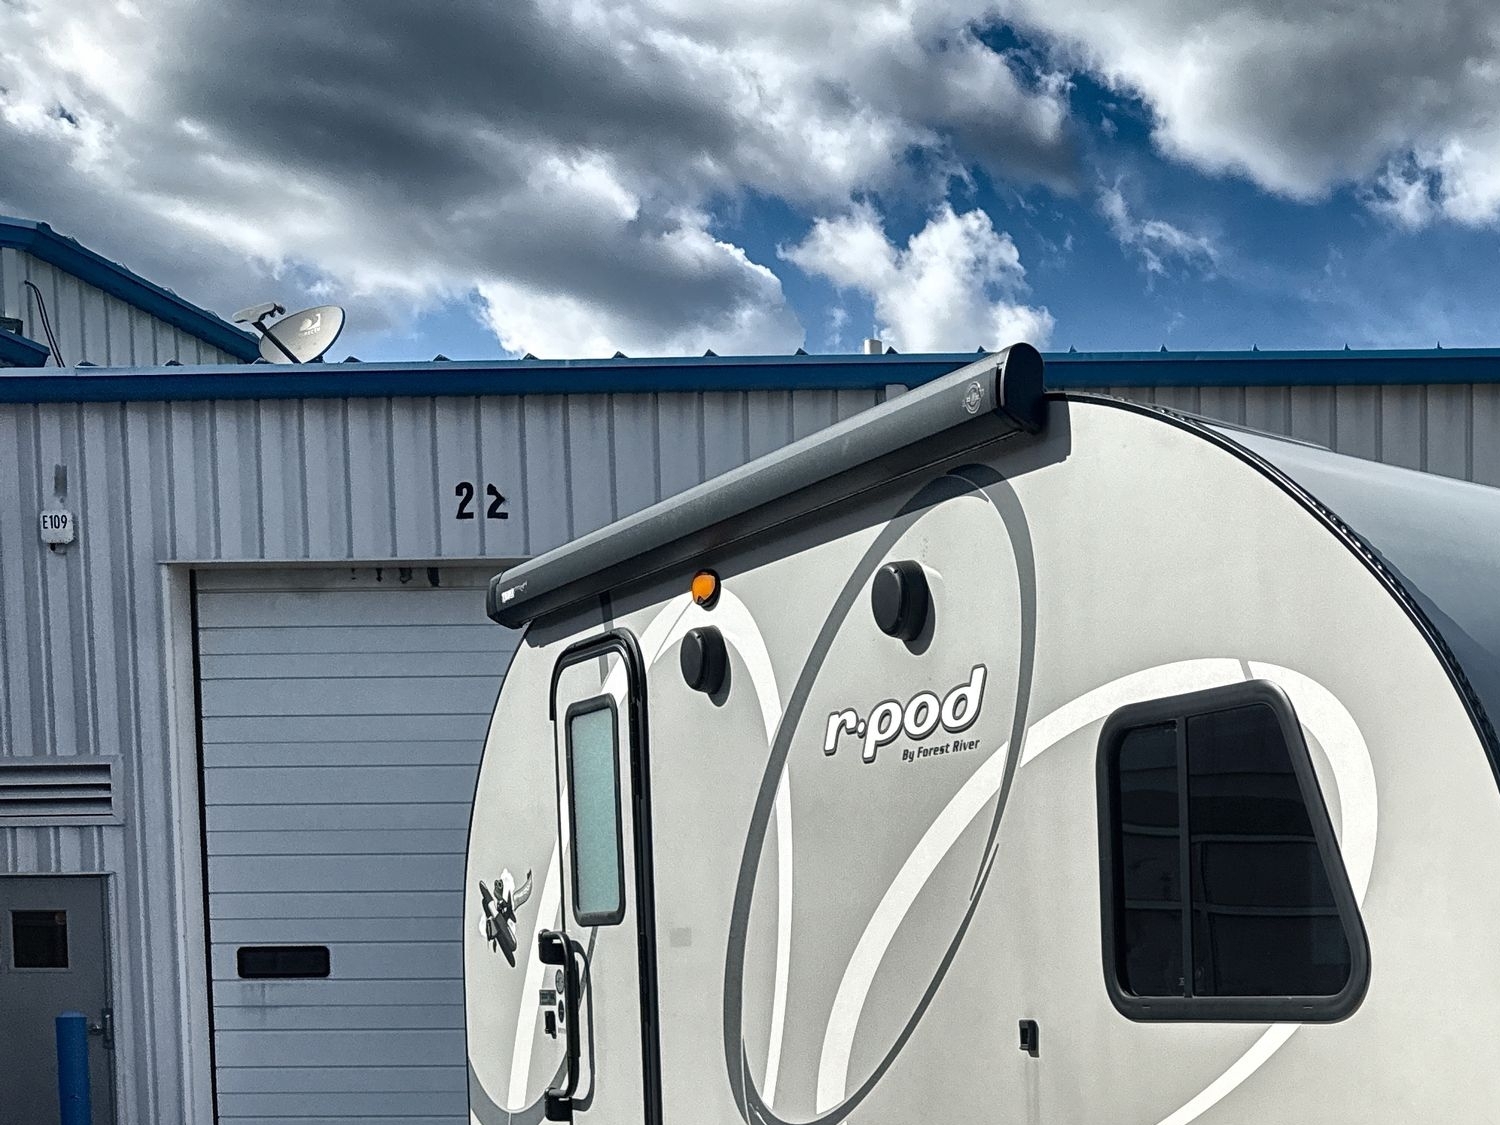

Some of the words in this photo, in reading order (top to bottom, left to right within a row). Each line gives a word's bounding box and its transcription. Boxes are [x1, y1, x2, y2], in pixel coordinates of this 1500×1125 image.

[455, 482, 508, 519] 22
[42, 514, 68, 529] E109
[902, 749, 914, 762] By
[917, 743, 950, 758] Forest
[952, 740, 980, 752] River
